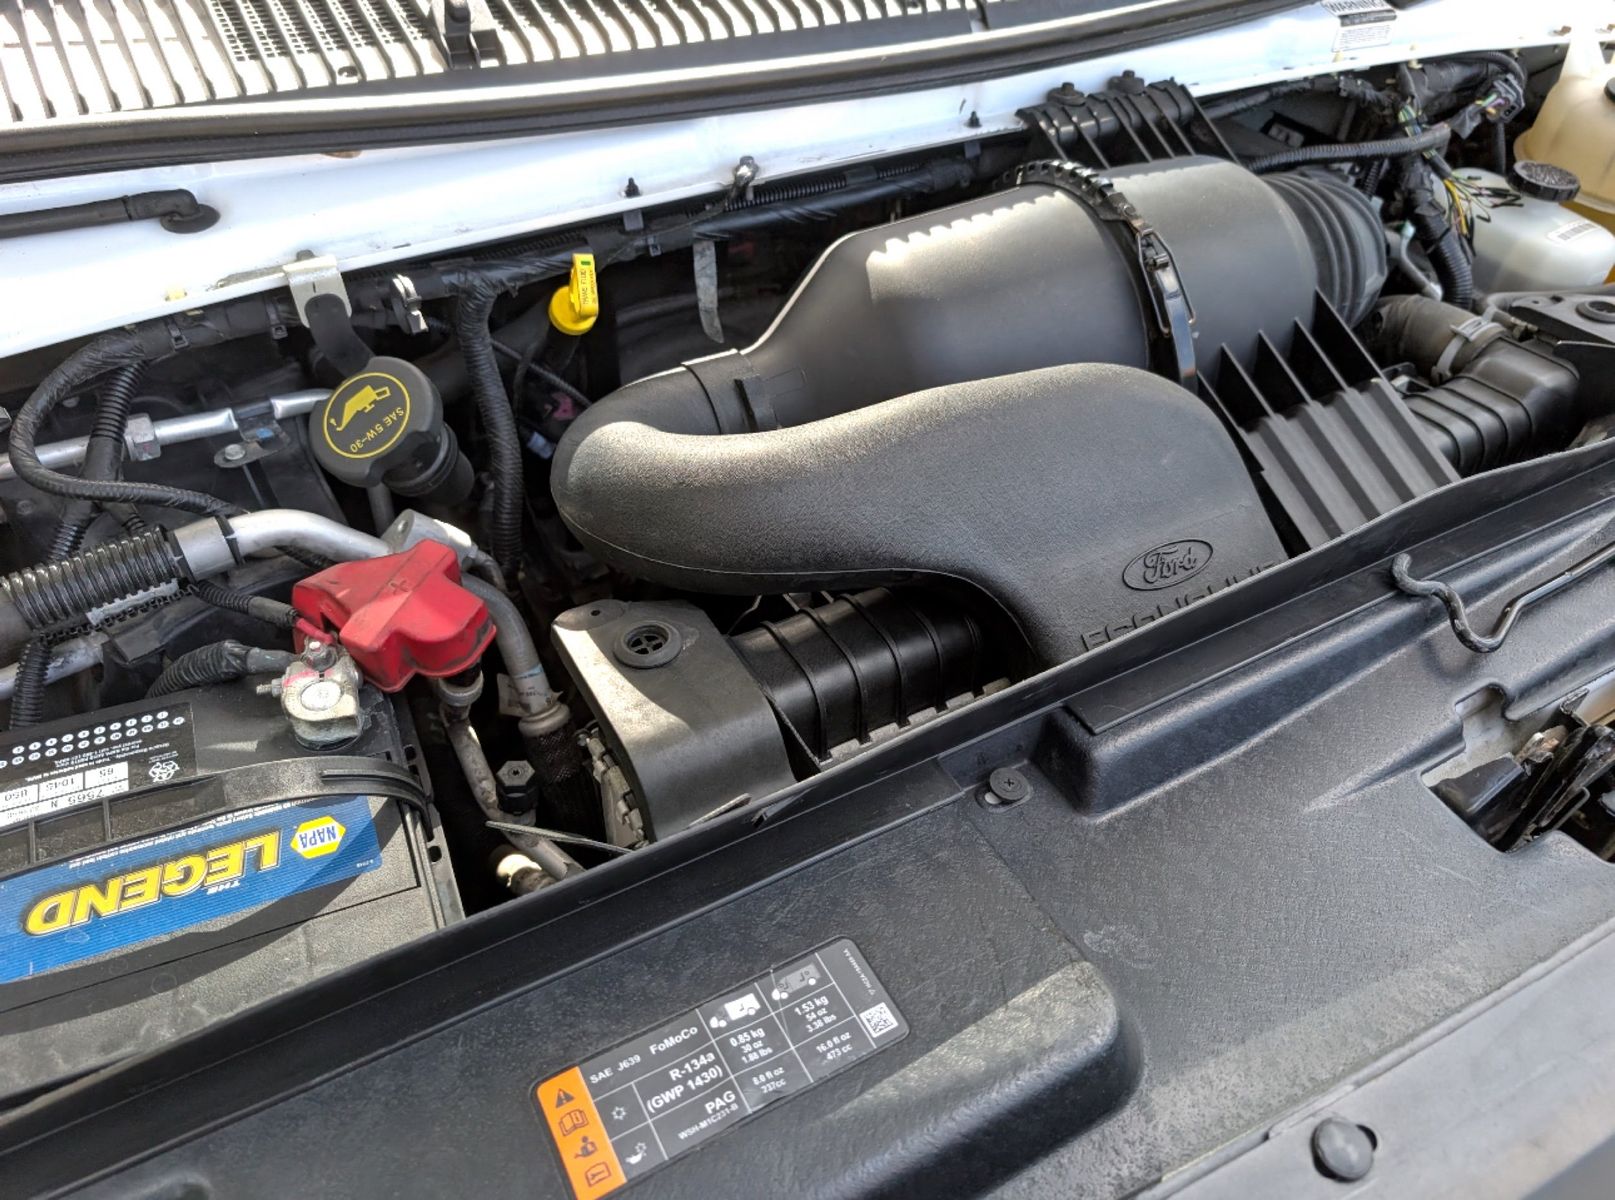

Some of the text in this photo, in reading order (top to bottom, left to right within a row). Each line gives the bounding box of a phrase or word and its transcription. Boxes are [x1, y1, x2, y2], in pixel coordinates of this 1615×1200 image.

[350, 407, 404, 453] SAE 5W-30
[1143, 545, 1198, 584] Ford
[299, 825, 337, 849] NAPA
[24, 830, 281, 936] LEGEND
[794, 996, 829, 1015] 1.53 kg
[805, 1007, 828, 1021] 54 oz
[823, 1014, 837, 1024] lbs
[649, 1027, 698, 1055] FoMoCo
[729, 1028, 765, 1047] 0.85 kg
[741, 1040, 763, 1053] 30 oz
[816, 1040, 834, 1053] 16.0
[840, 1032, 852, 1041] oz
[758, 1047, 773, 1057] lbs
[589, 1054, 641, 1084] SAE J639
[669, 1052, 715, 1081] R-134a
[773, 1067, 784, 1076] oz
[646, 1065, 723, 1113] (GWP 1430)
[704, 1090, 736, 1114] PAG
